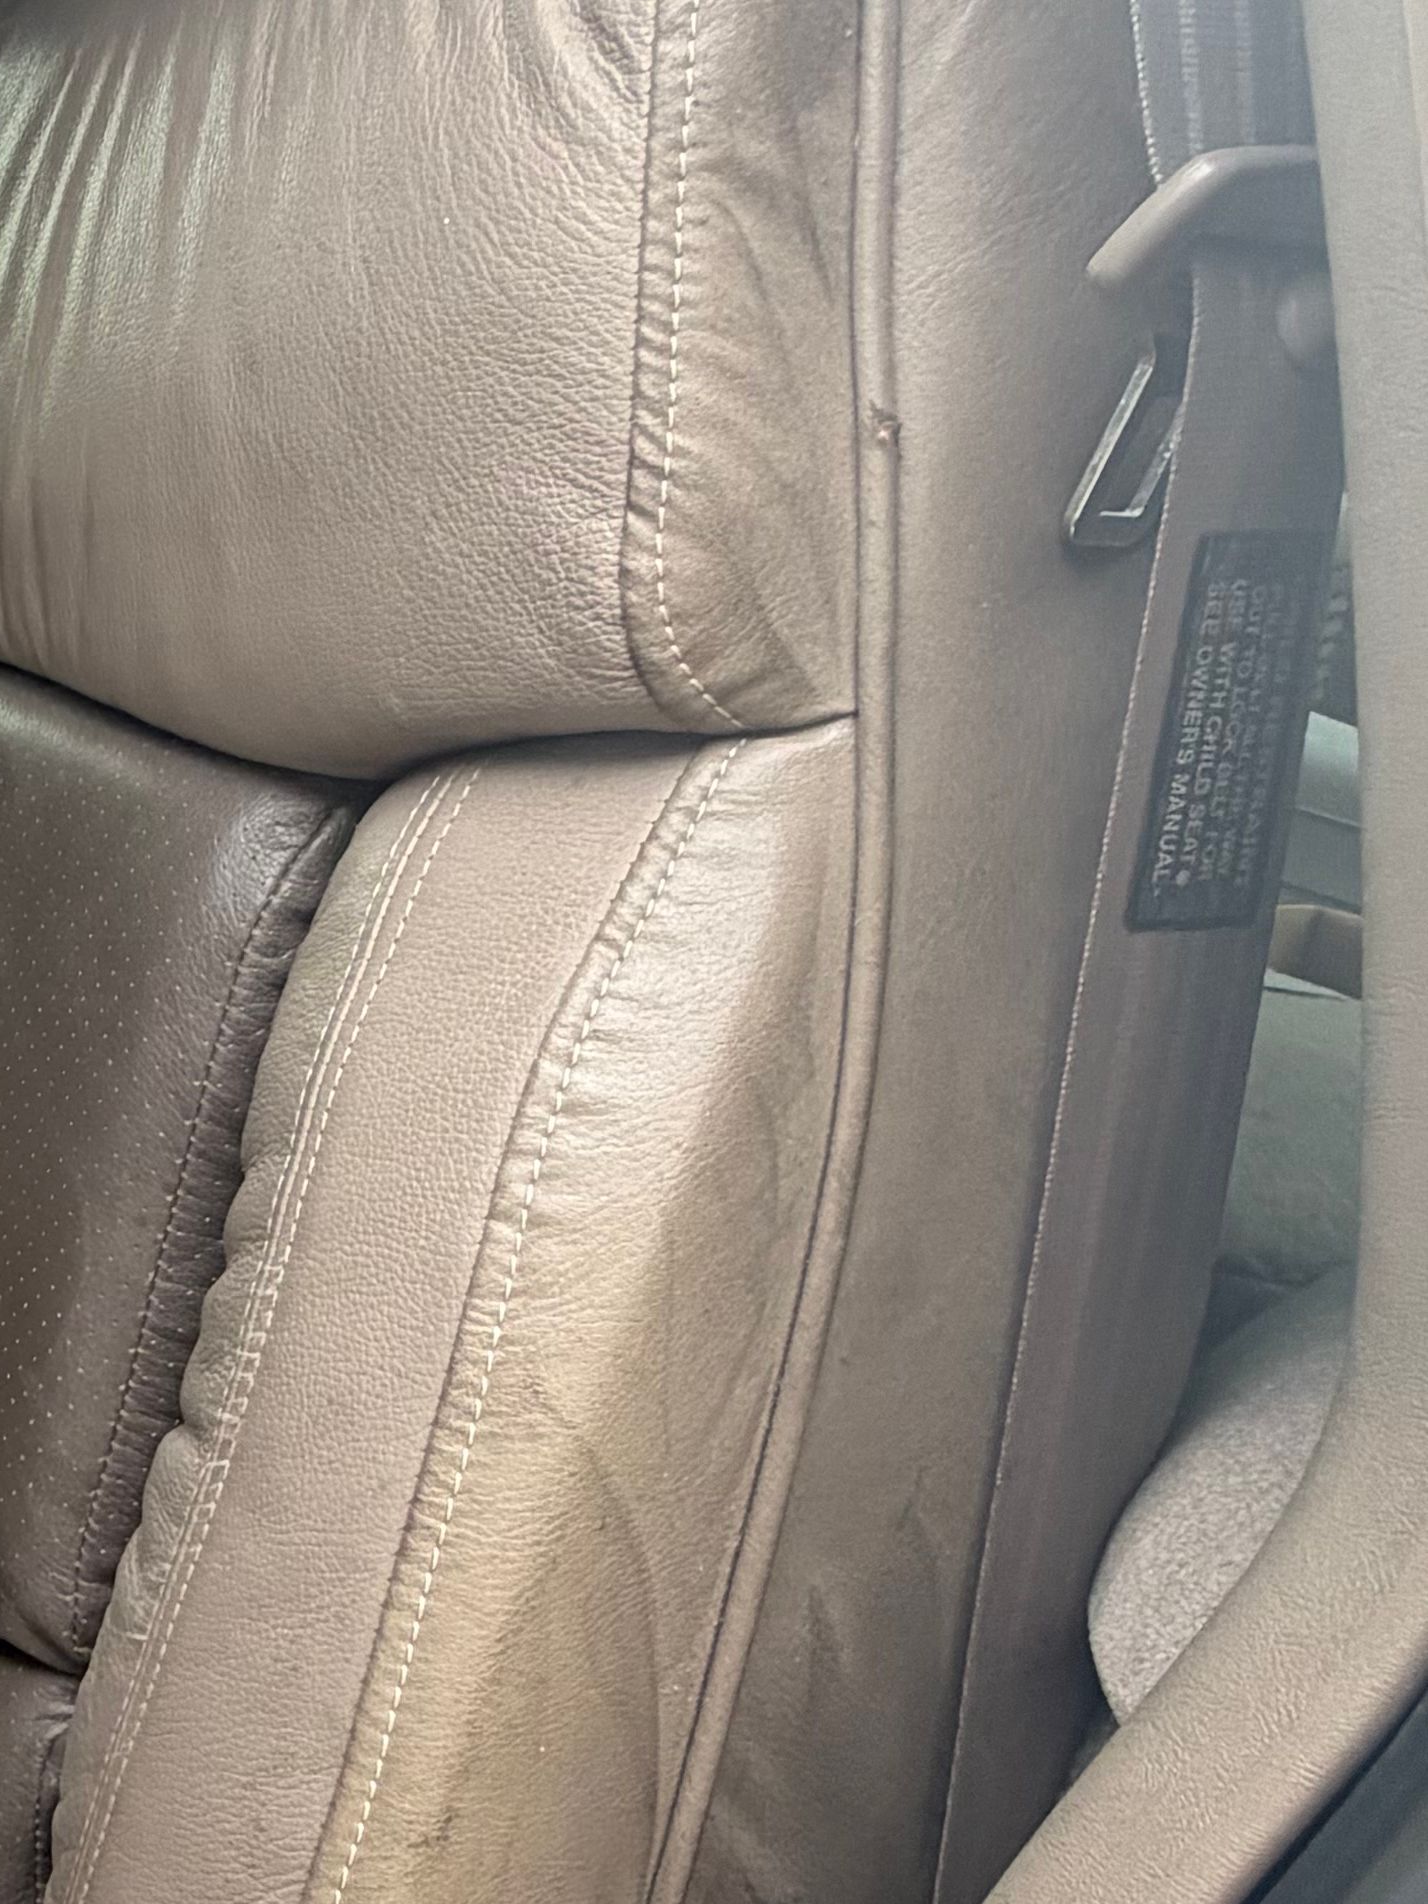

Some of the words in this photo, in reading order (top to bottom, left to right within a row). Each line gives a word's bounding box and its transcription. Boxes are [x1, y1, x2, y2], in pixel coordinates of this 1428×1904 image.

[1198, 581, 1227, 635] SEE
[1221, 578, 1251, 634] USE
[1244, 585, 1269, 634] OUT
[1208, 641, 1239, 708] WITH
[1236, 644, 1258, 678] TO
[1174, 645, 1216, 764] OWNER'S
[1220, 685, 1250, 755] LOCK
[1191, 716, 1224, 795] CHILD
[1215, 827, 1238, 876] WAY
